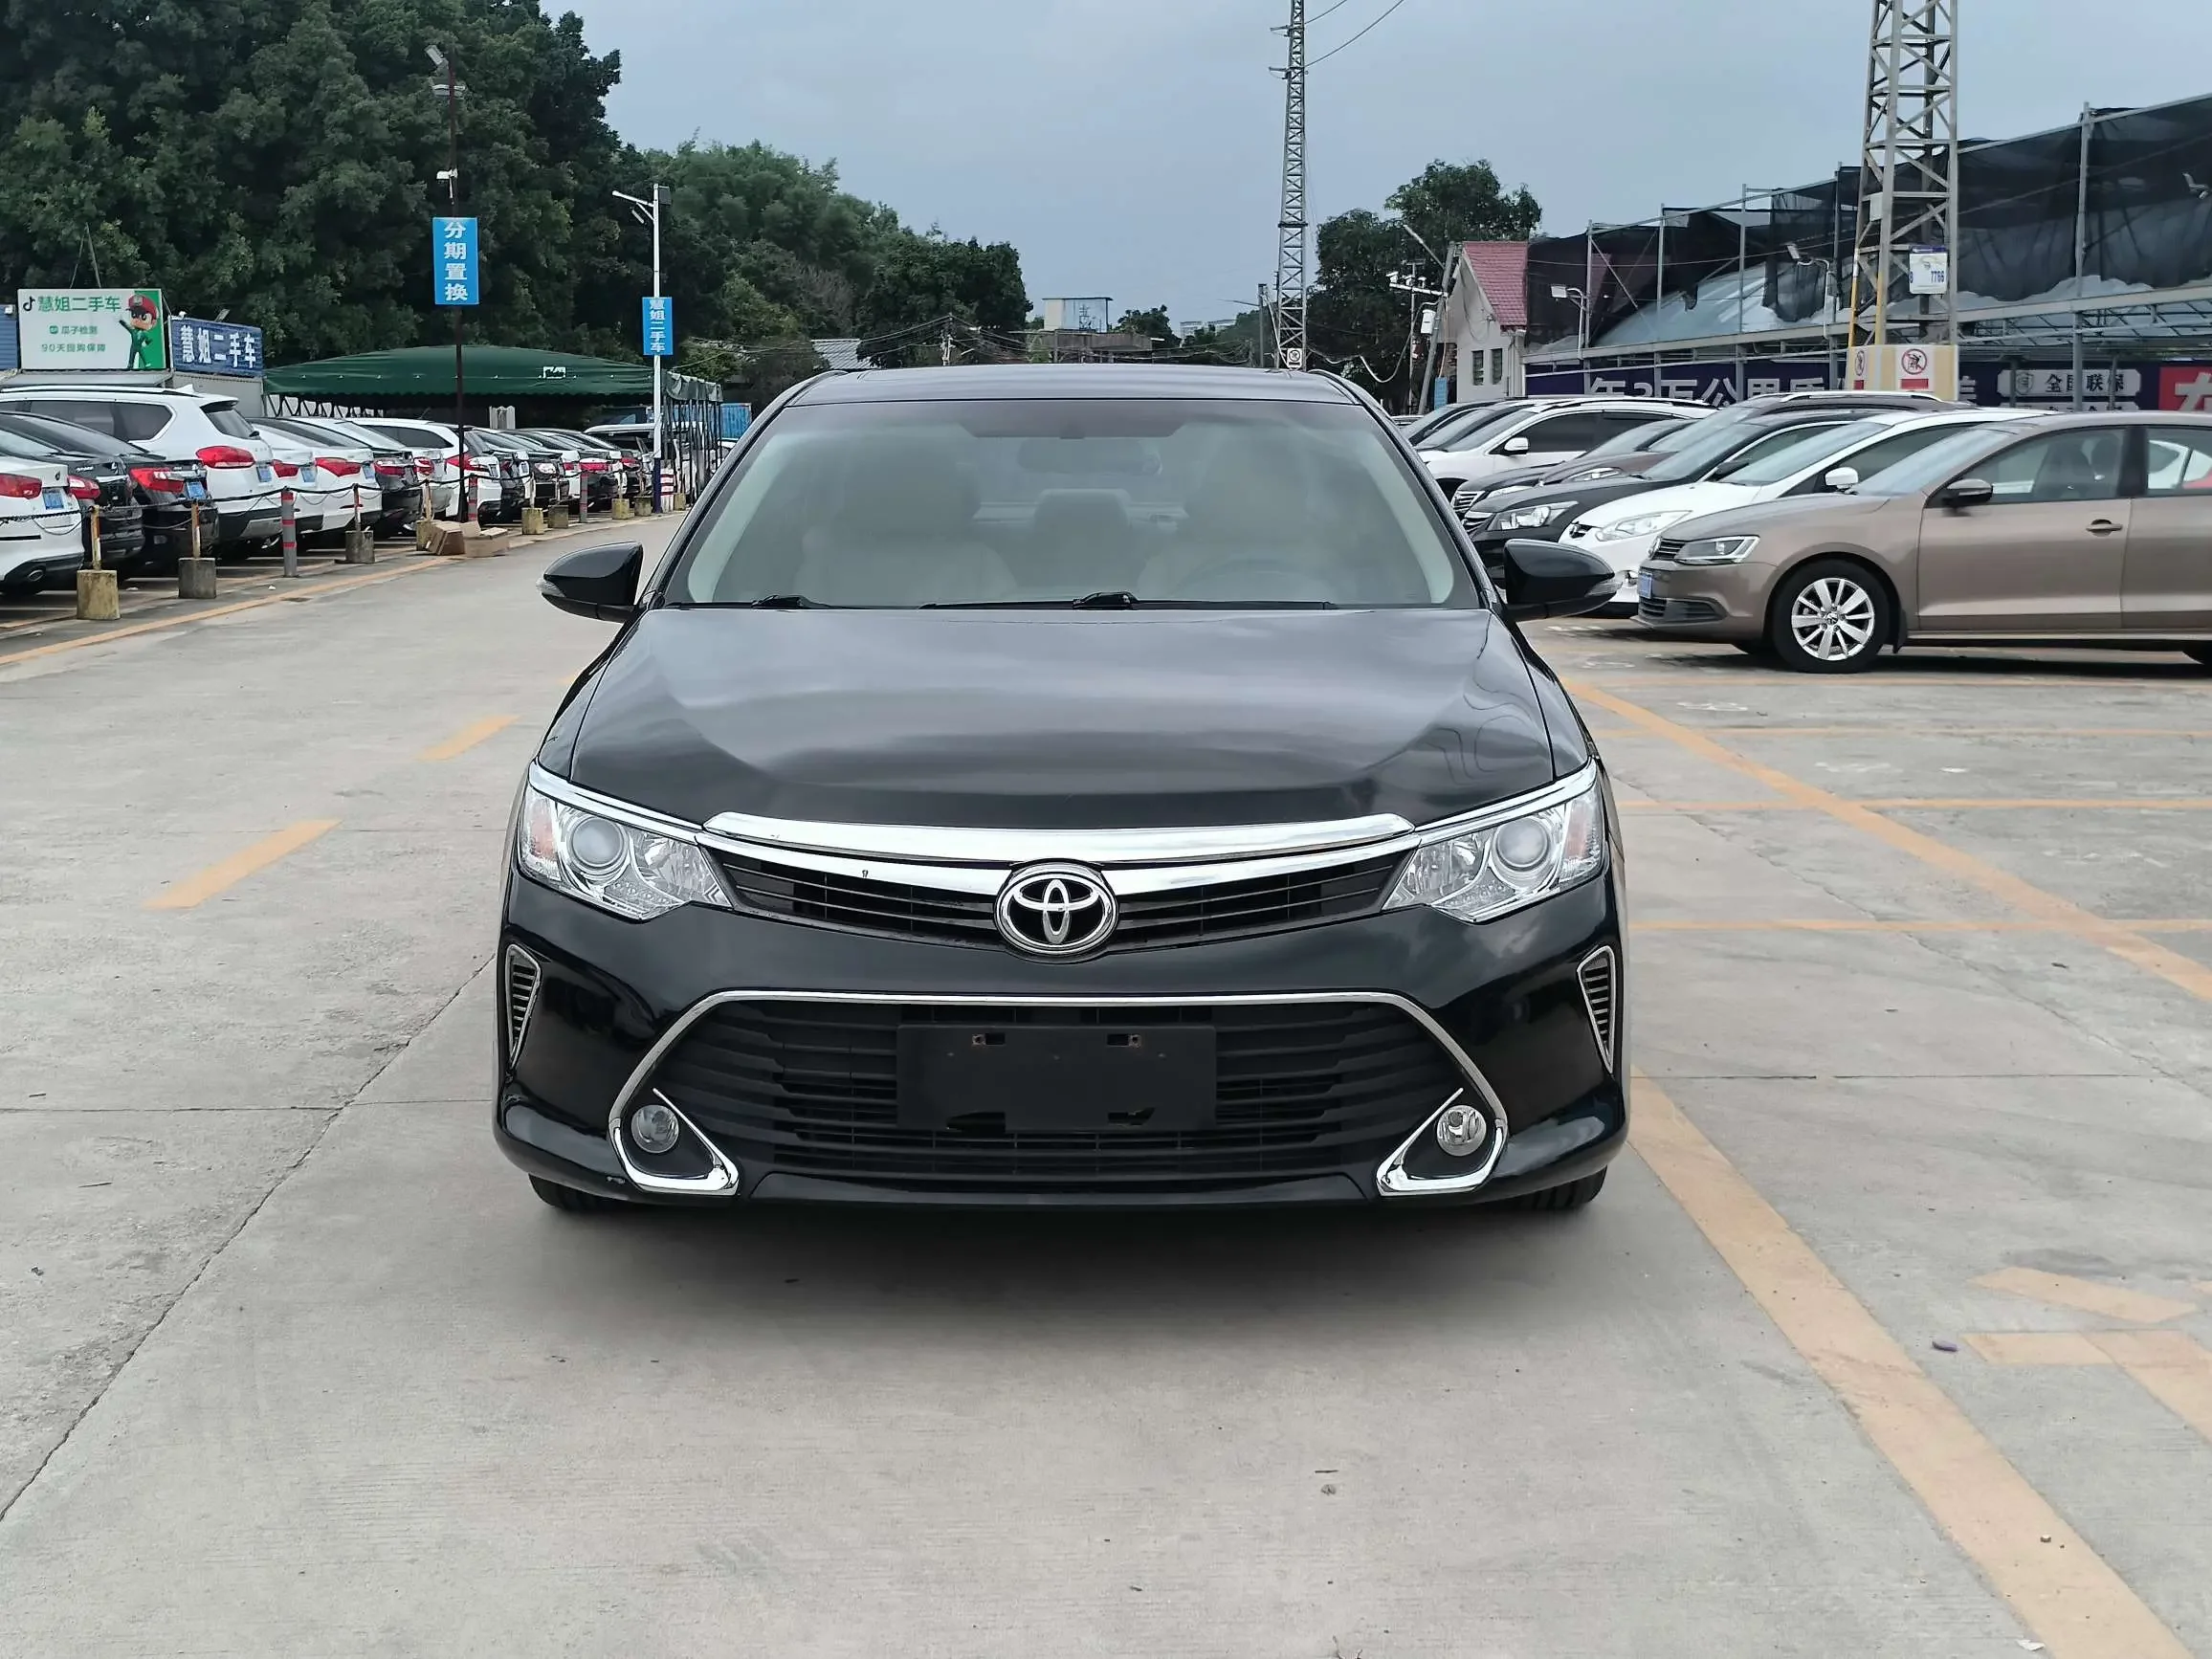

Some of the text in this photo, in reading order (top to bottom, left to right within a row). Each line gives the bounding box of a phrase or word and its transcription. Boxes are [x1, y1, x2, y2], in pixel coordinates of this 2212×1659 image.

[444, 221, 469, 301] 分期置换
[38, 295, 122, 313] 慧姐二手车
[180, 323, 256, 369] 慧姐二手车
